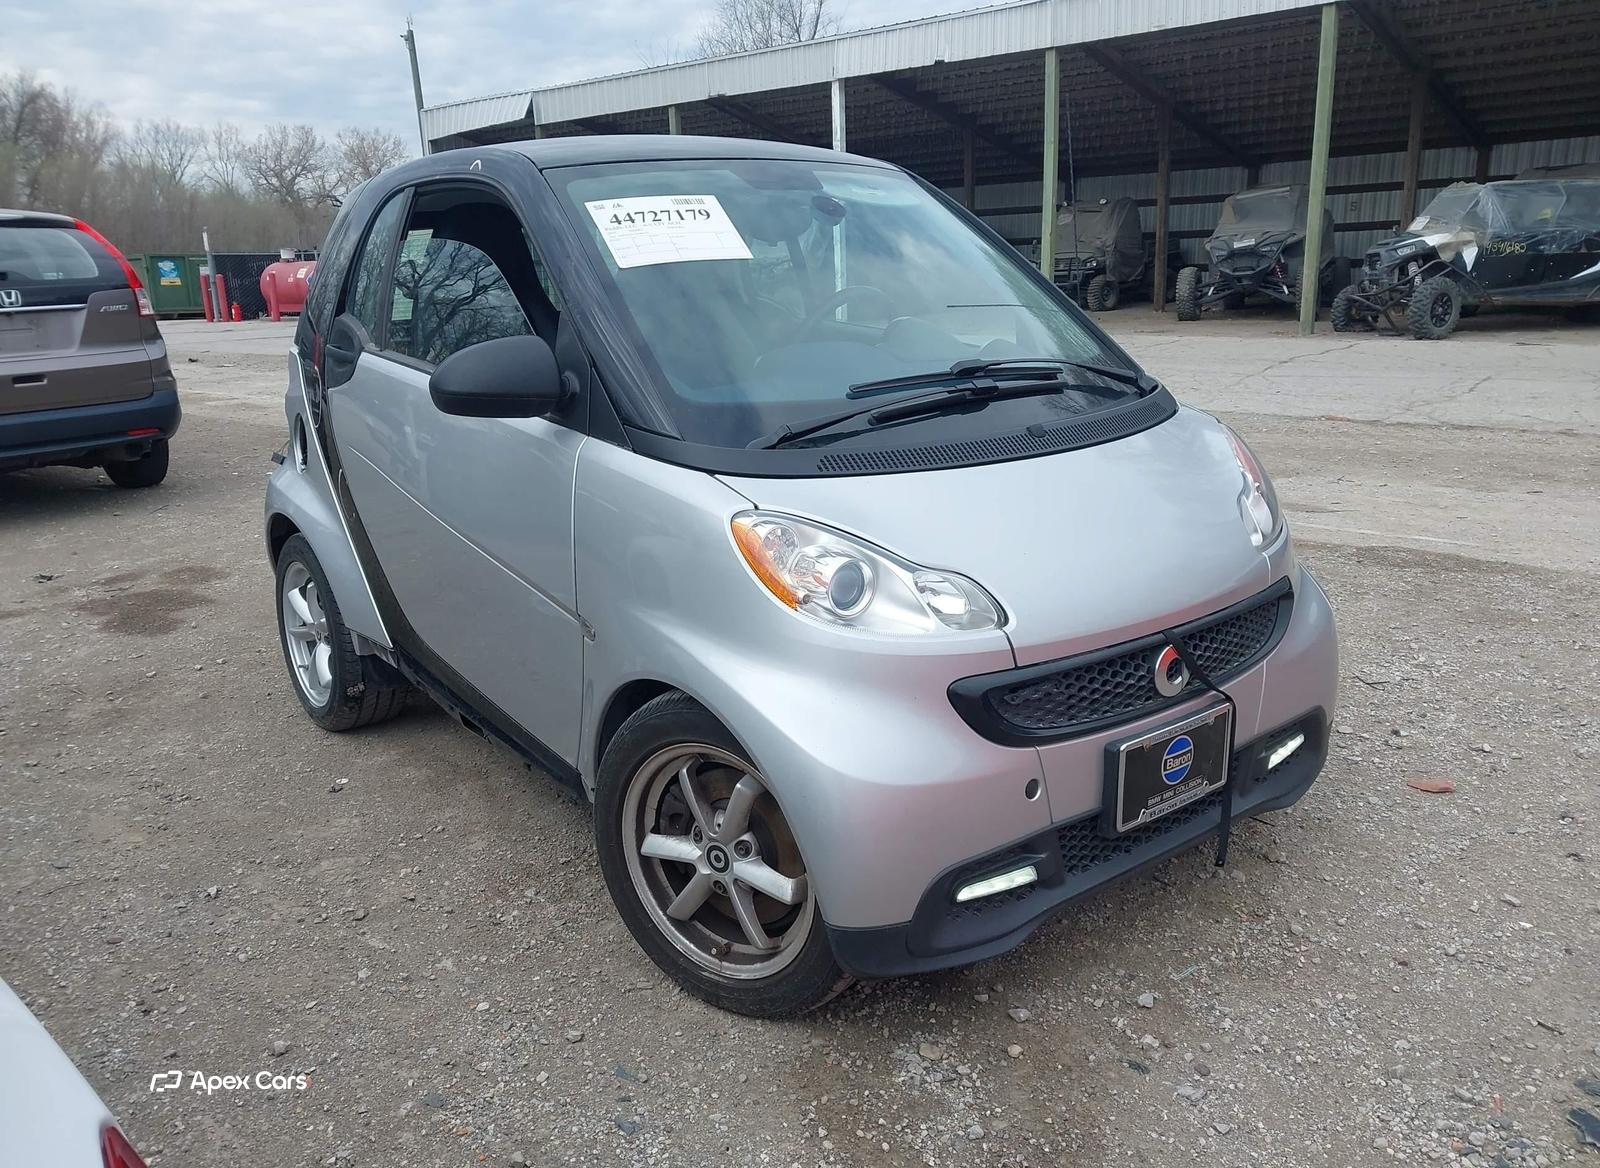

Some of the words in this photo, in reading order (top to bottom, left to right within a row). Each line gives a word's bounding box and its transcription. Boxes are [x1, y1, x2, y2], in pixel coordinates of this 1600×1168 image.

[1350, 201, 1358, 212] 5
[609, 208, 711, 224] 44727179
[99, 304, 129, 313] AWD
[1166, 753, 1191, 770] Baron
[1147, 796, 1162, 806] BMW
[1162, 790, 1175, 799] MINI
[1176, 779, 1202, 792] COLLISION
[1151, 803, 1177, 817] Baron
